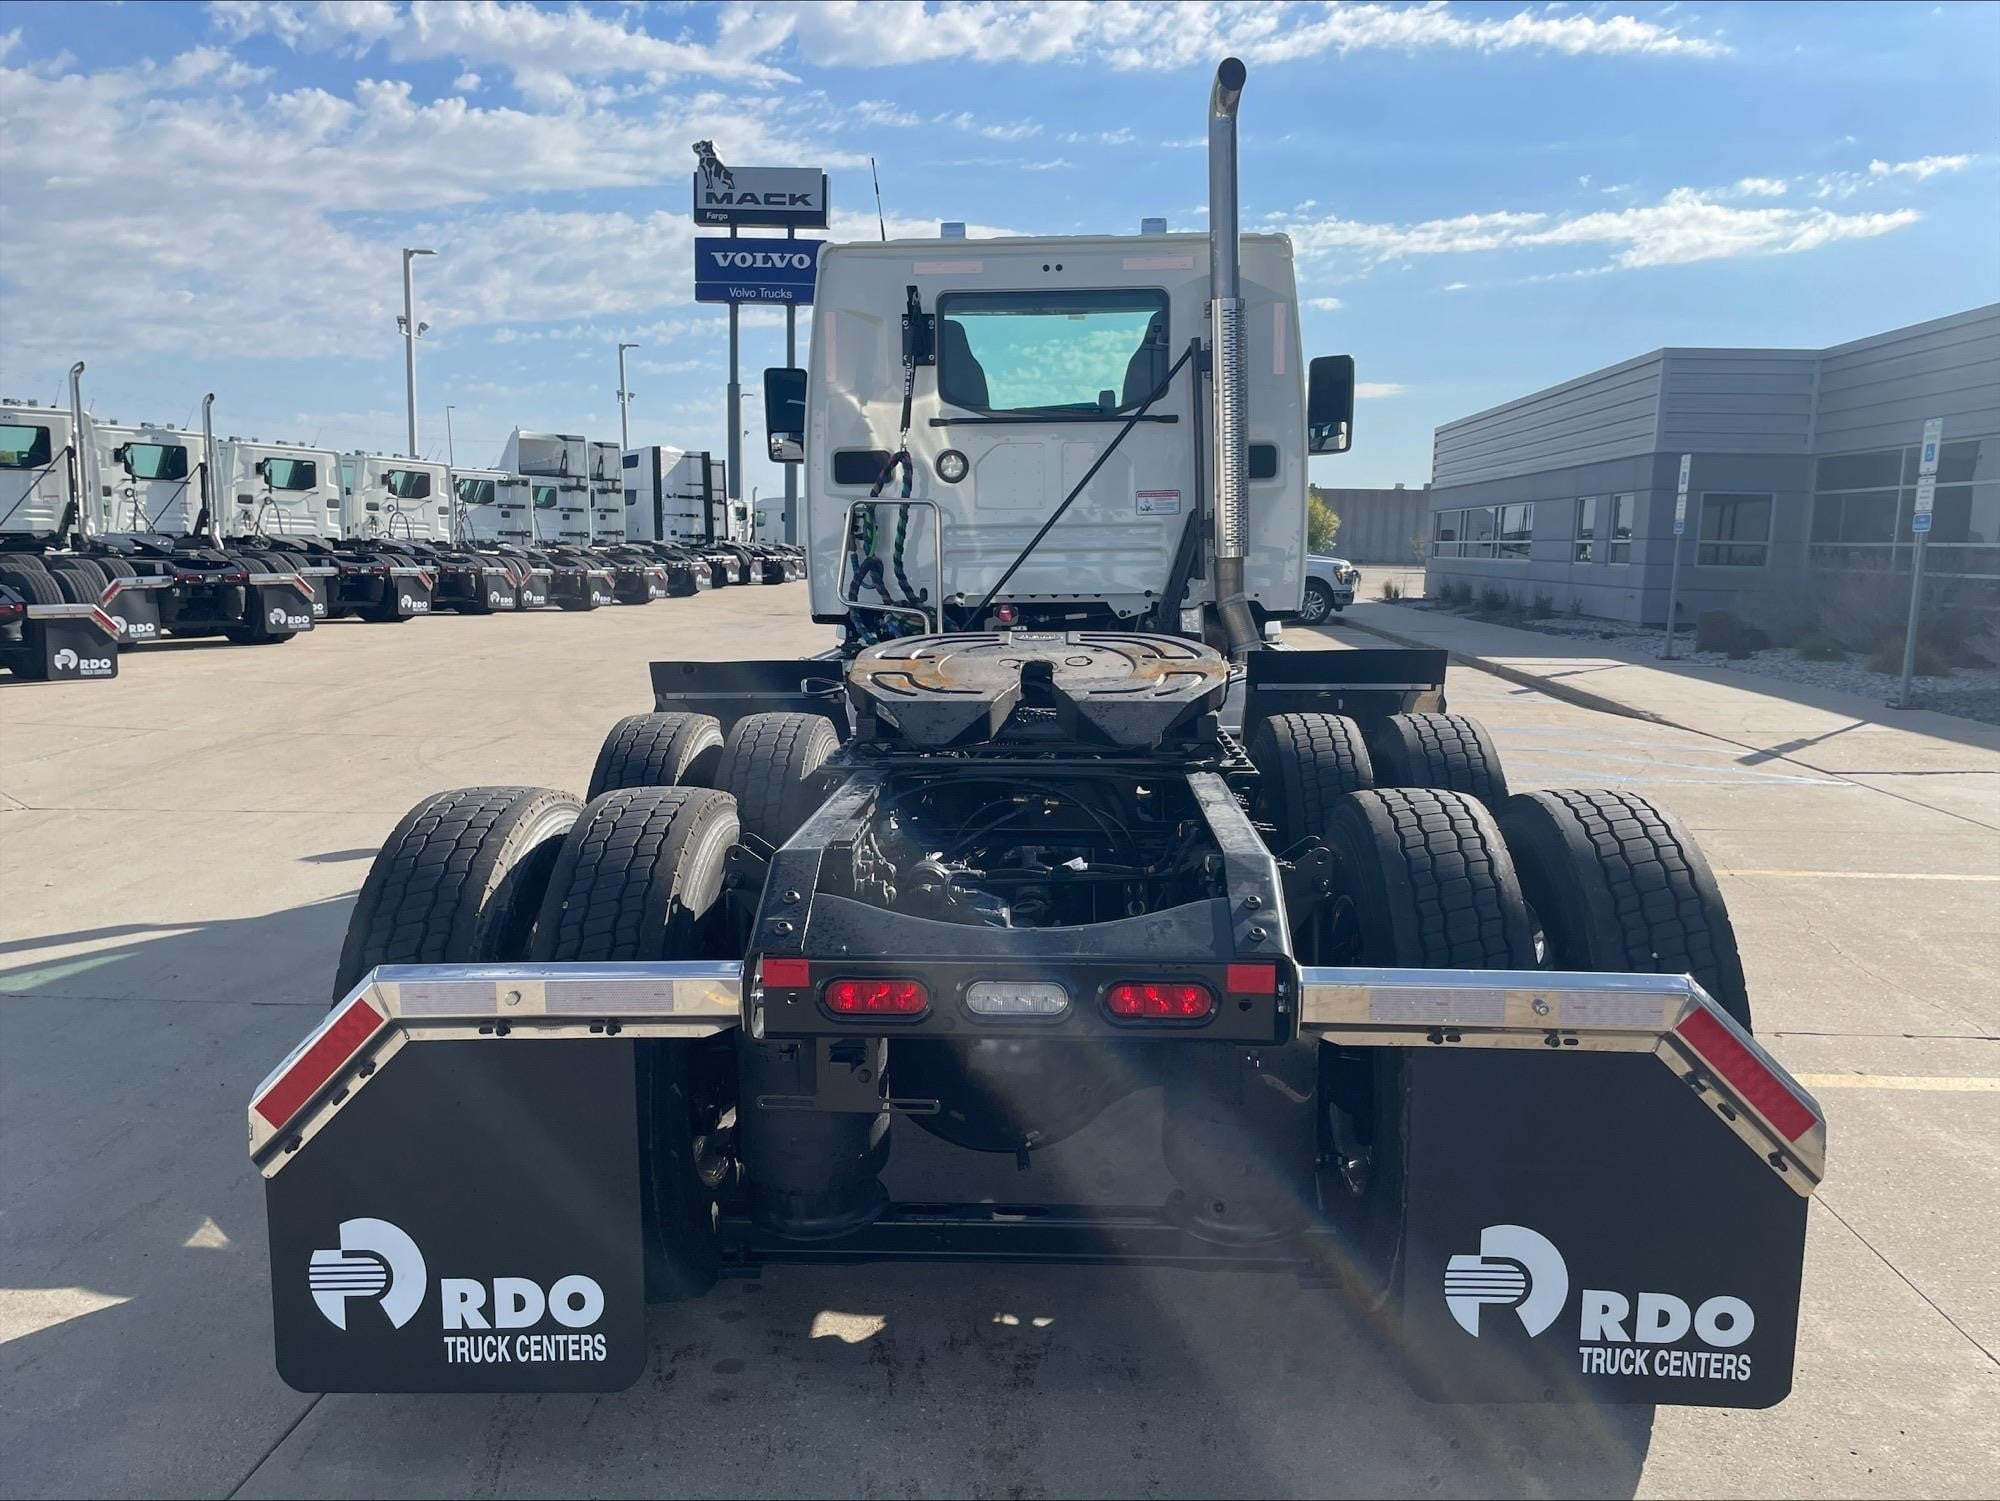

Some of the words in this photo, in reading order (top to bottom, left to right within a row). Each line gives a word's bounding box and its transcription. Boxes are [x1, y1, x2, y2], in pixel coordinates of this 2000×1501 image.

[705, 192, 813, 206] MACK
[706, 211, 728, 221] Fargo
[711, 252, 811, 269] VOLVO
[729, 287, 756, 298] Volvo
[759, 287, 792, 299] Trucks
[287, 615, 310, 624] RDO
[128, 622, 155, 633] RDO
[80, 658, 111, 669] RDO
[441, 1274, 605, 1330] RDO
[1579, 1289, 1755, 1348] RDO
[443, 1335, 511, 1363] TRUCK
[516, 1333, 607, 1362] CENTERS
[1578, 1347, 1649, 1375] TRUCK
[1654, 1350, 1751, 1381] CENTERS
